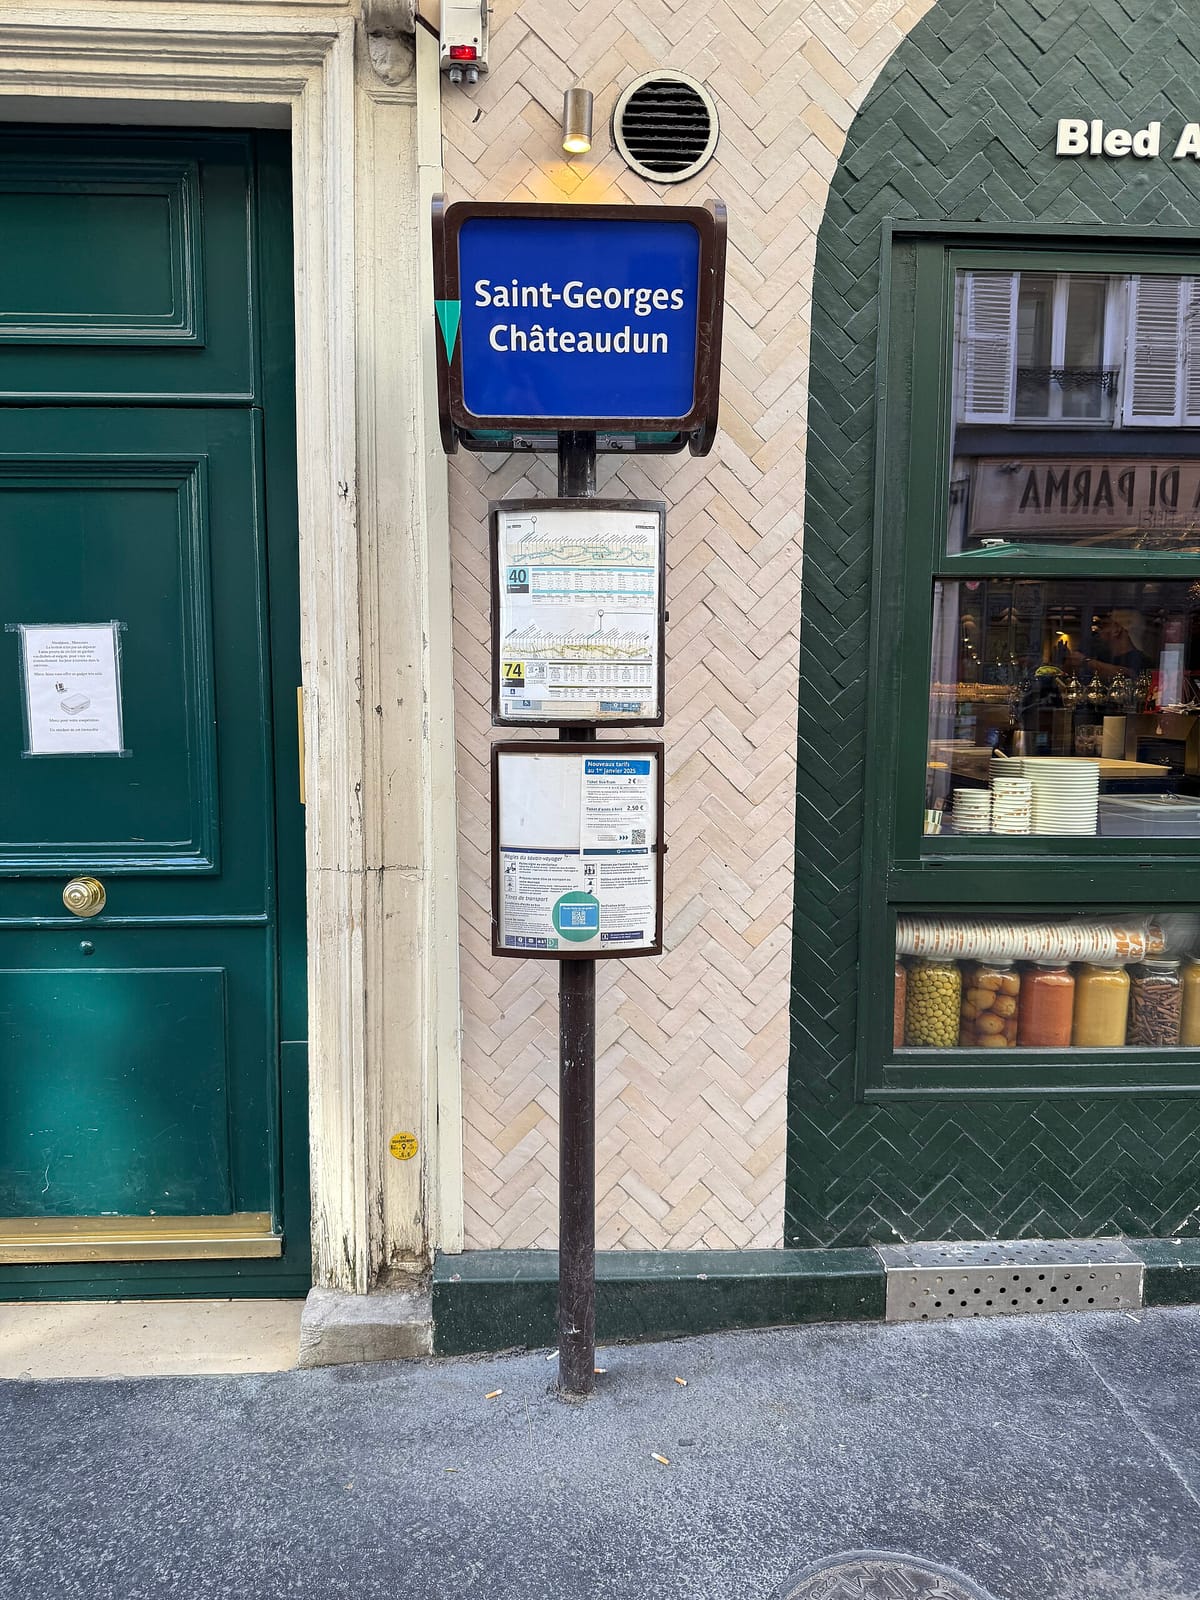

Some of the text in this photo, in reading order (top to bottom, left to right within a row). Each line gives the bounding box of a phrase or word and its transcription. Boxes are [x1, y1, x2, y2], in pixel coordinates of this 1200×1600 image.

[1056, 118, 1161, 157] Bled
[474, 279, 684, 316] Saint-Georges
[489, 324, 669, 353] Châteaudun
[509, 569, 527, 583] 40
[504, 663, 522, 677] 74
